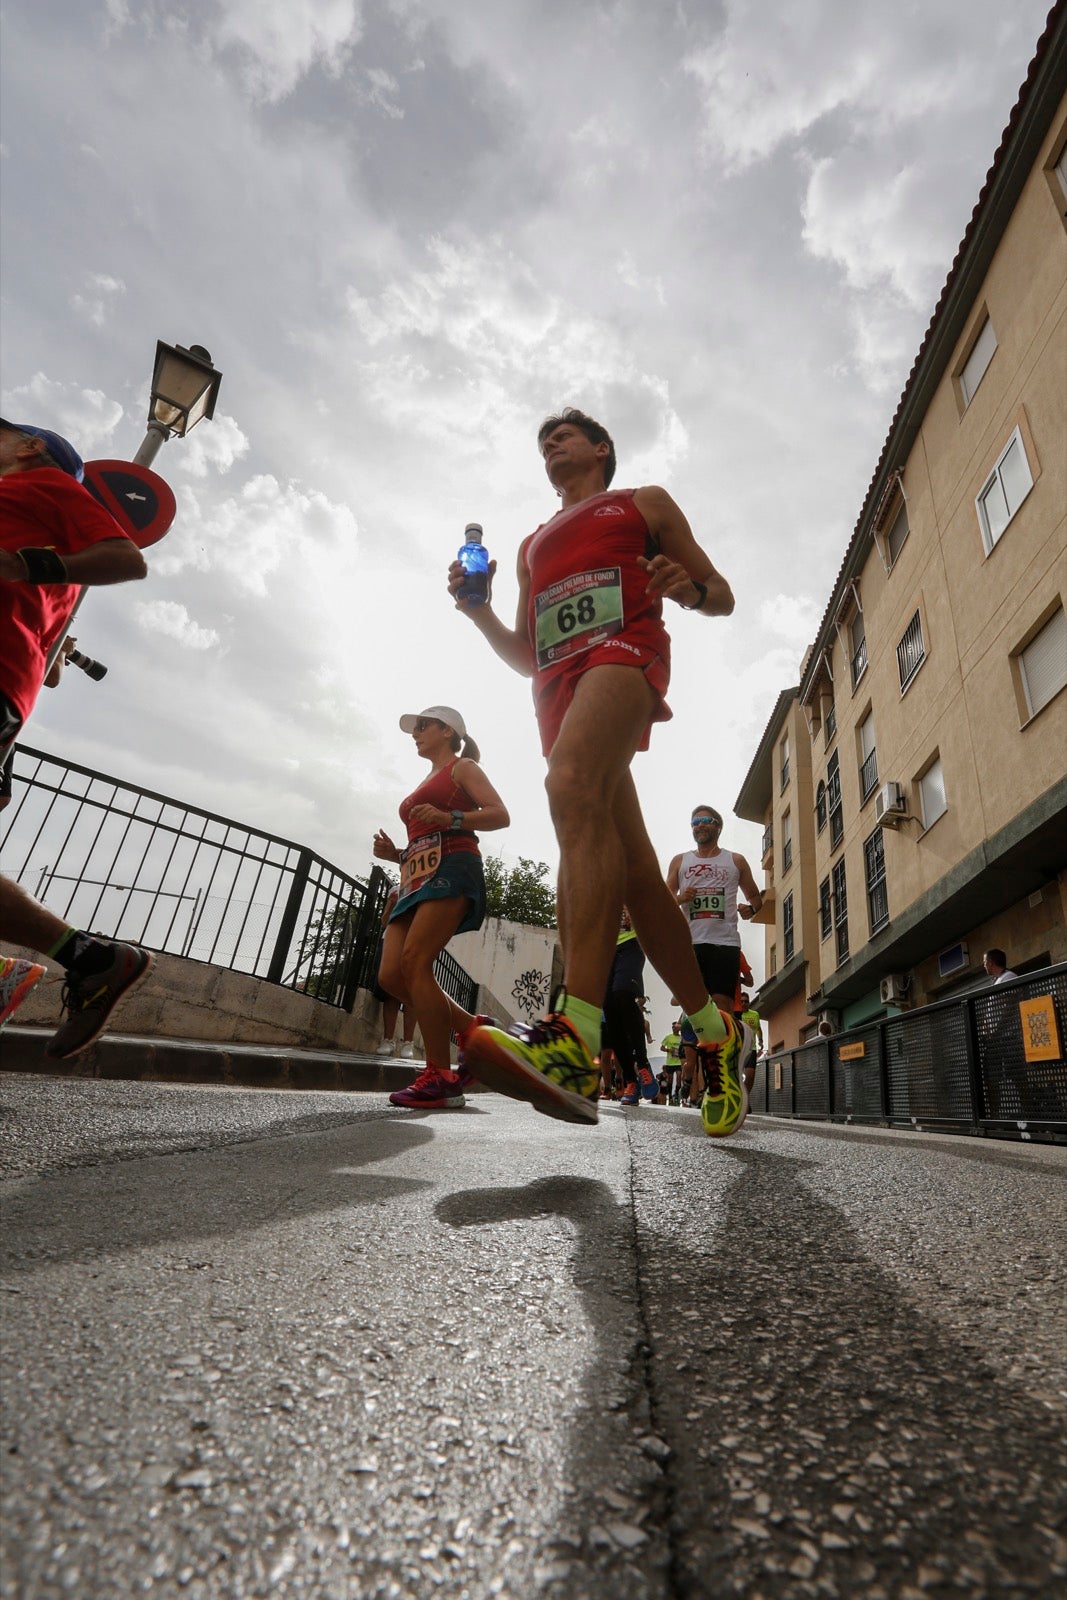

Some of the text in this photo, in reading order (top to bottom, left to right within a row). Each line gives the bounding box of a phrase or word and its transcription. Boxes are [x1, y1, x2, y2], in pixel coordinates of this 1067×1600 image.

[584, 573, 593, 582] DE
[557, 595, 595, 633] 68
[693, 896, 720, 909] 919
